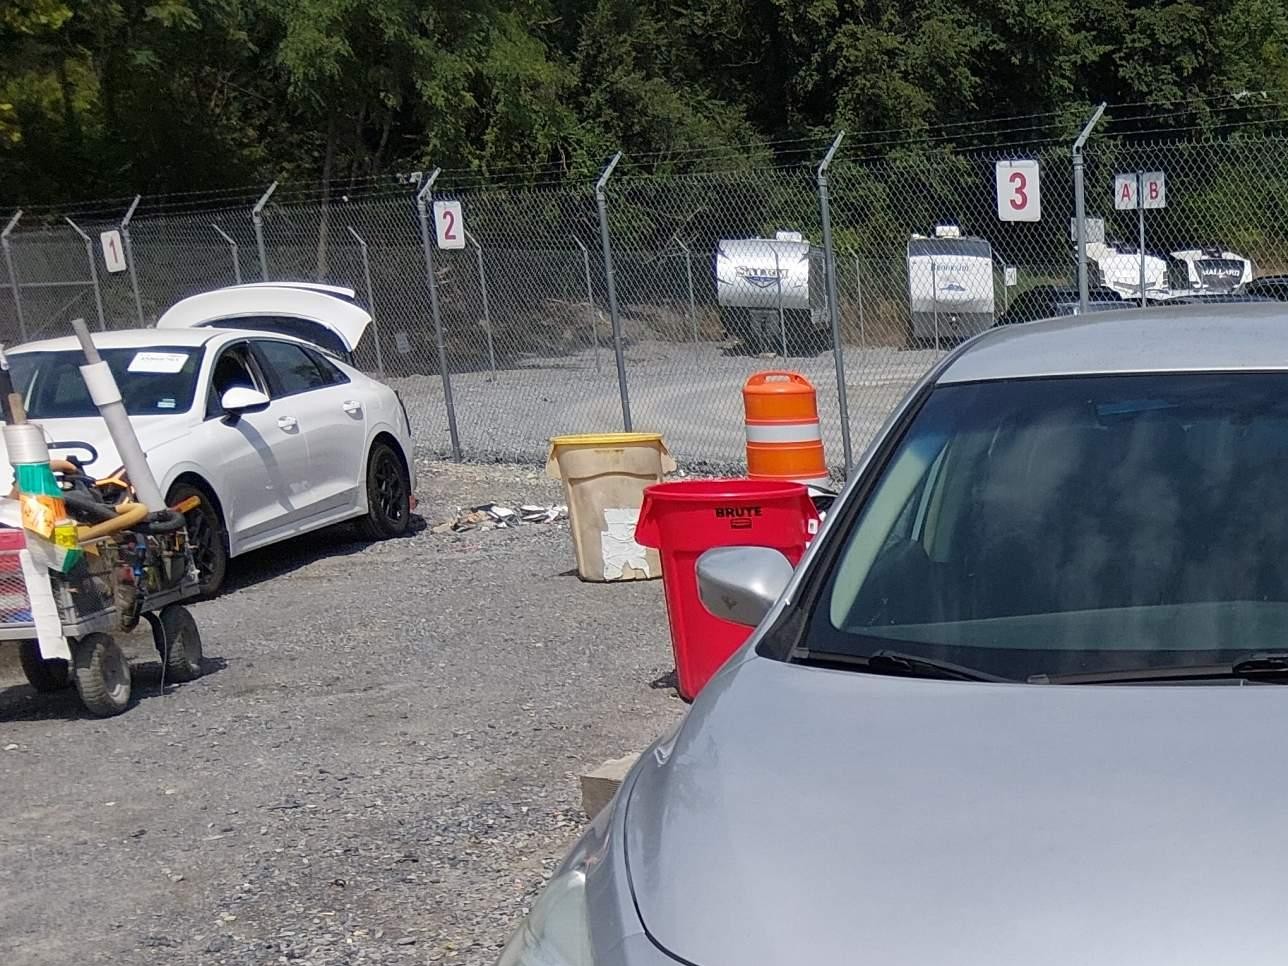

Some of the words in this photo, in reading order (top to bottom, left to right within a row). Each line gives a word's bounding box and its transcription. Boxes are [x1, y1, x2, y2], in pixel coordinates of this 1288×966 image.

[1009, 172, 1028, 210] 3
[1121, 183, 1131, 201] A
[1150, 182, 1159, 200] B
[442, 210, 457, 240] 2
[109, 237, 118, 264] 1
[715, 506, 763, 518] BRUTE
